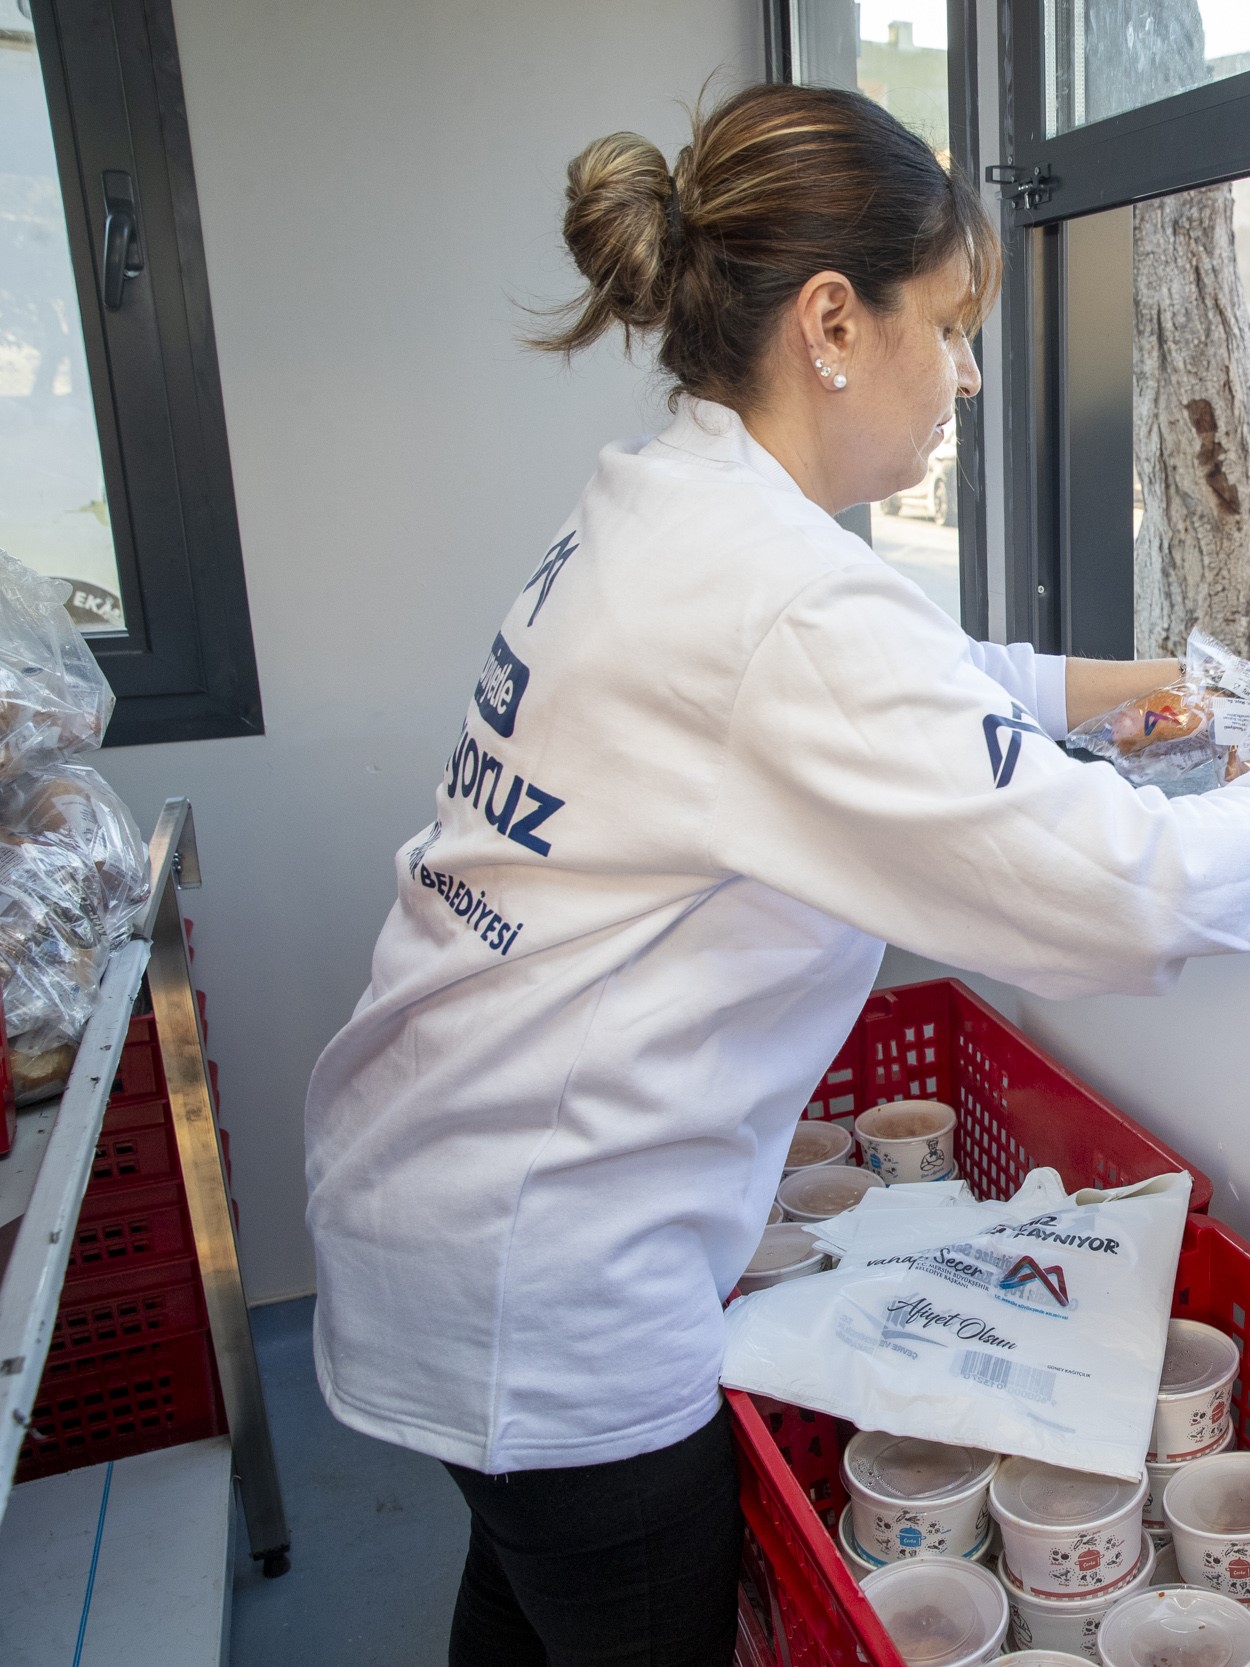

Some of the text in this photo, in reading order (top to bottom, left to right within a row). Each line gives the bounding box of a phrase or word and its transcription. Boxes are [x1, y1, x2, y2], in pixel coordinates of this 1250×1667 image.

[447, 731, 566, 858] yoruz
[420, 863, 524, 956] BELEDİYESİ
[933, 1247, 983, 1277] Seçer
[887, 1297, 1018, 1350] Afiyet Olsun
